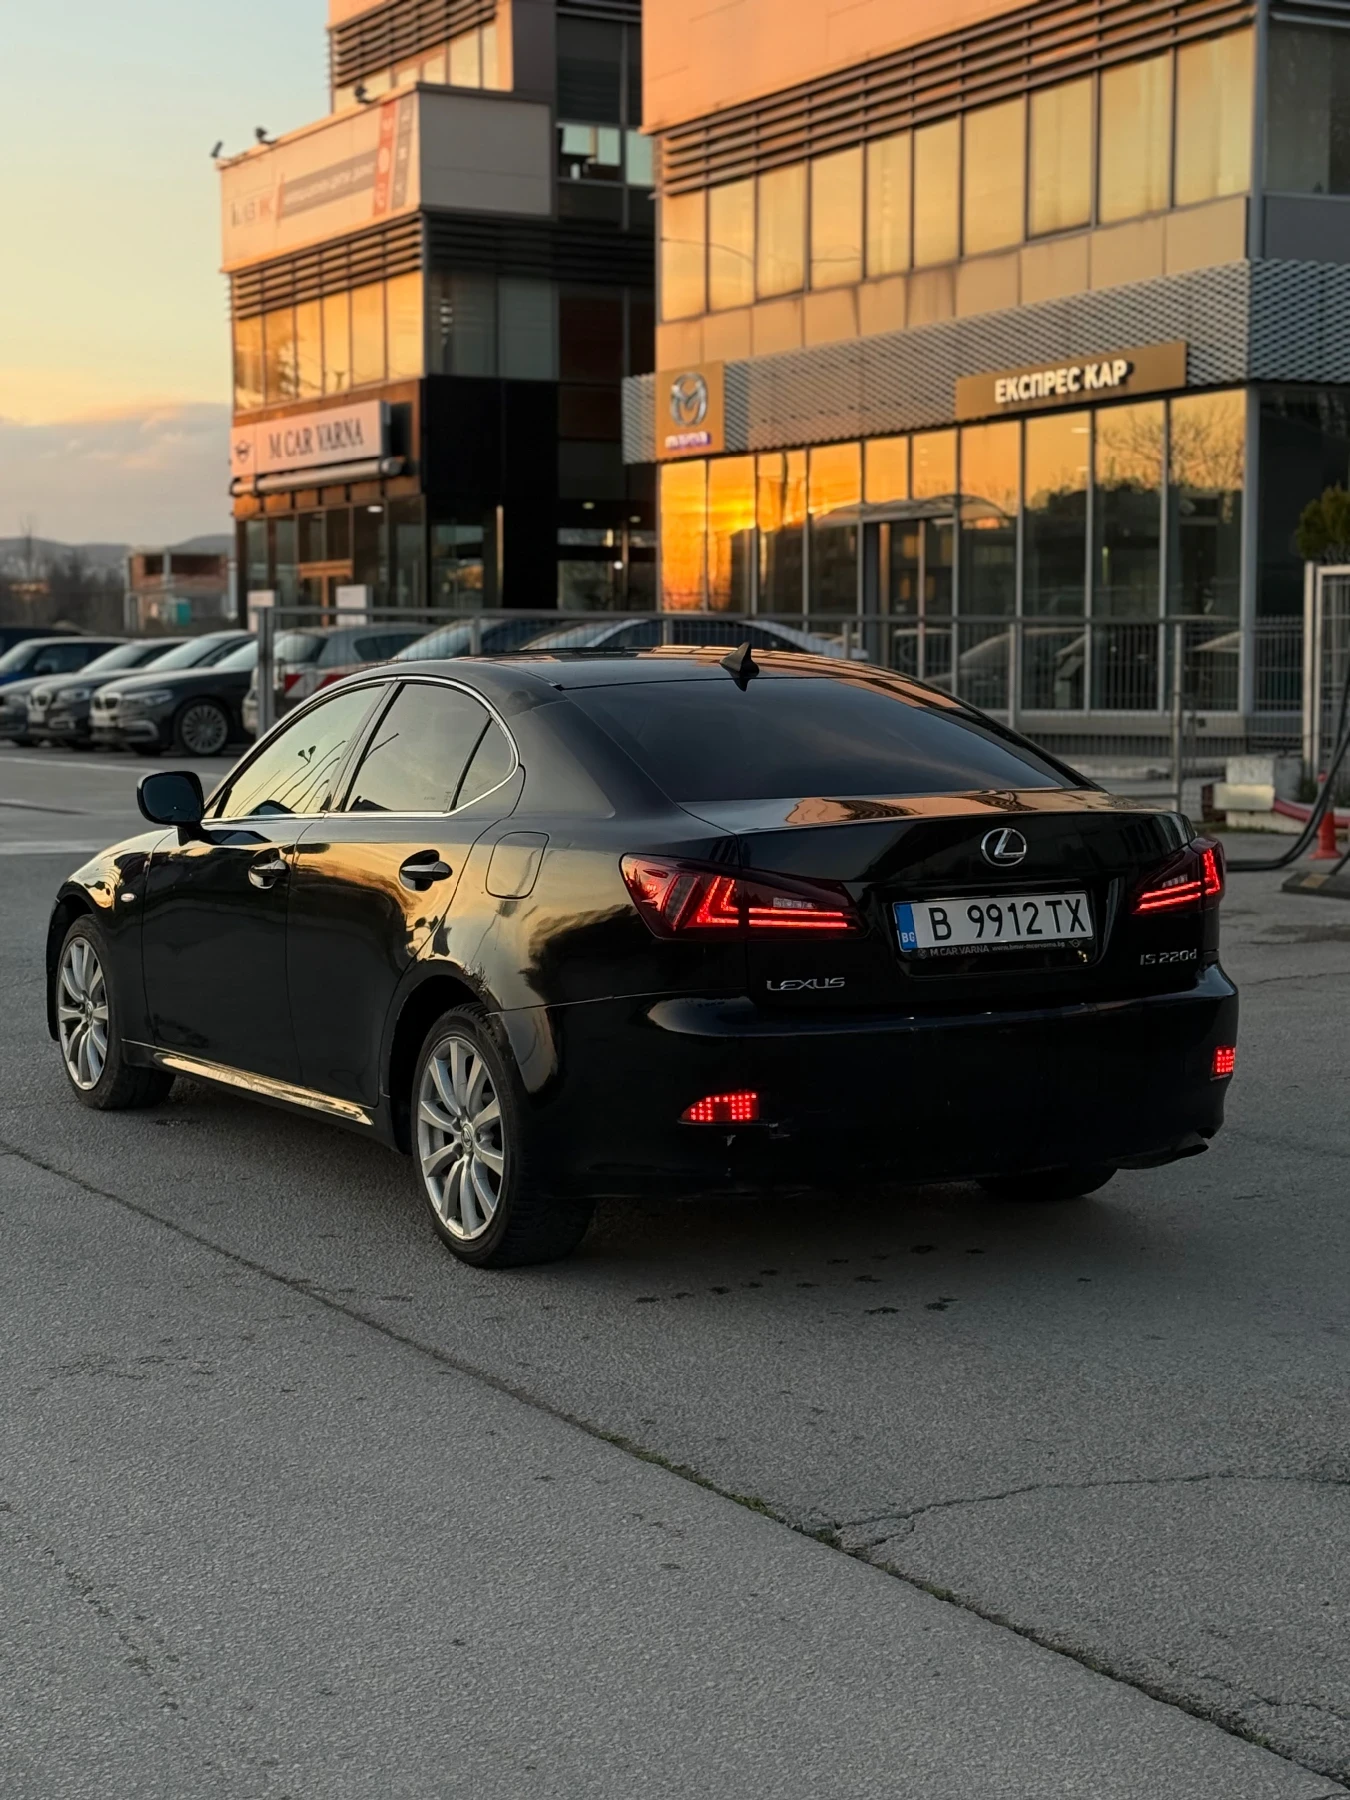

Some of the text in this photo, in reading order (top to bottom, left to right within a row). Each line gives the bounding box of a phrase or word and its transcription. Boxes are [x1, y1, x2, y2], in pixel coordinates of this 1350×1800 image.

[994, 359, 1128, 404] ЕКСПРЕС КАР
[284, 427, 314, 457] CAR
[316, 418, 364, 451] VARNA
[928, 906, 952, 941] B
[901, 931, 915, 944] BG
[940, 947, 959, 957] CAR
[959, 944, 990, 955] VARNA
[1140, 948, 1197, 966] IS 220d
[766, 977, 846, 991] LEXUS
